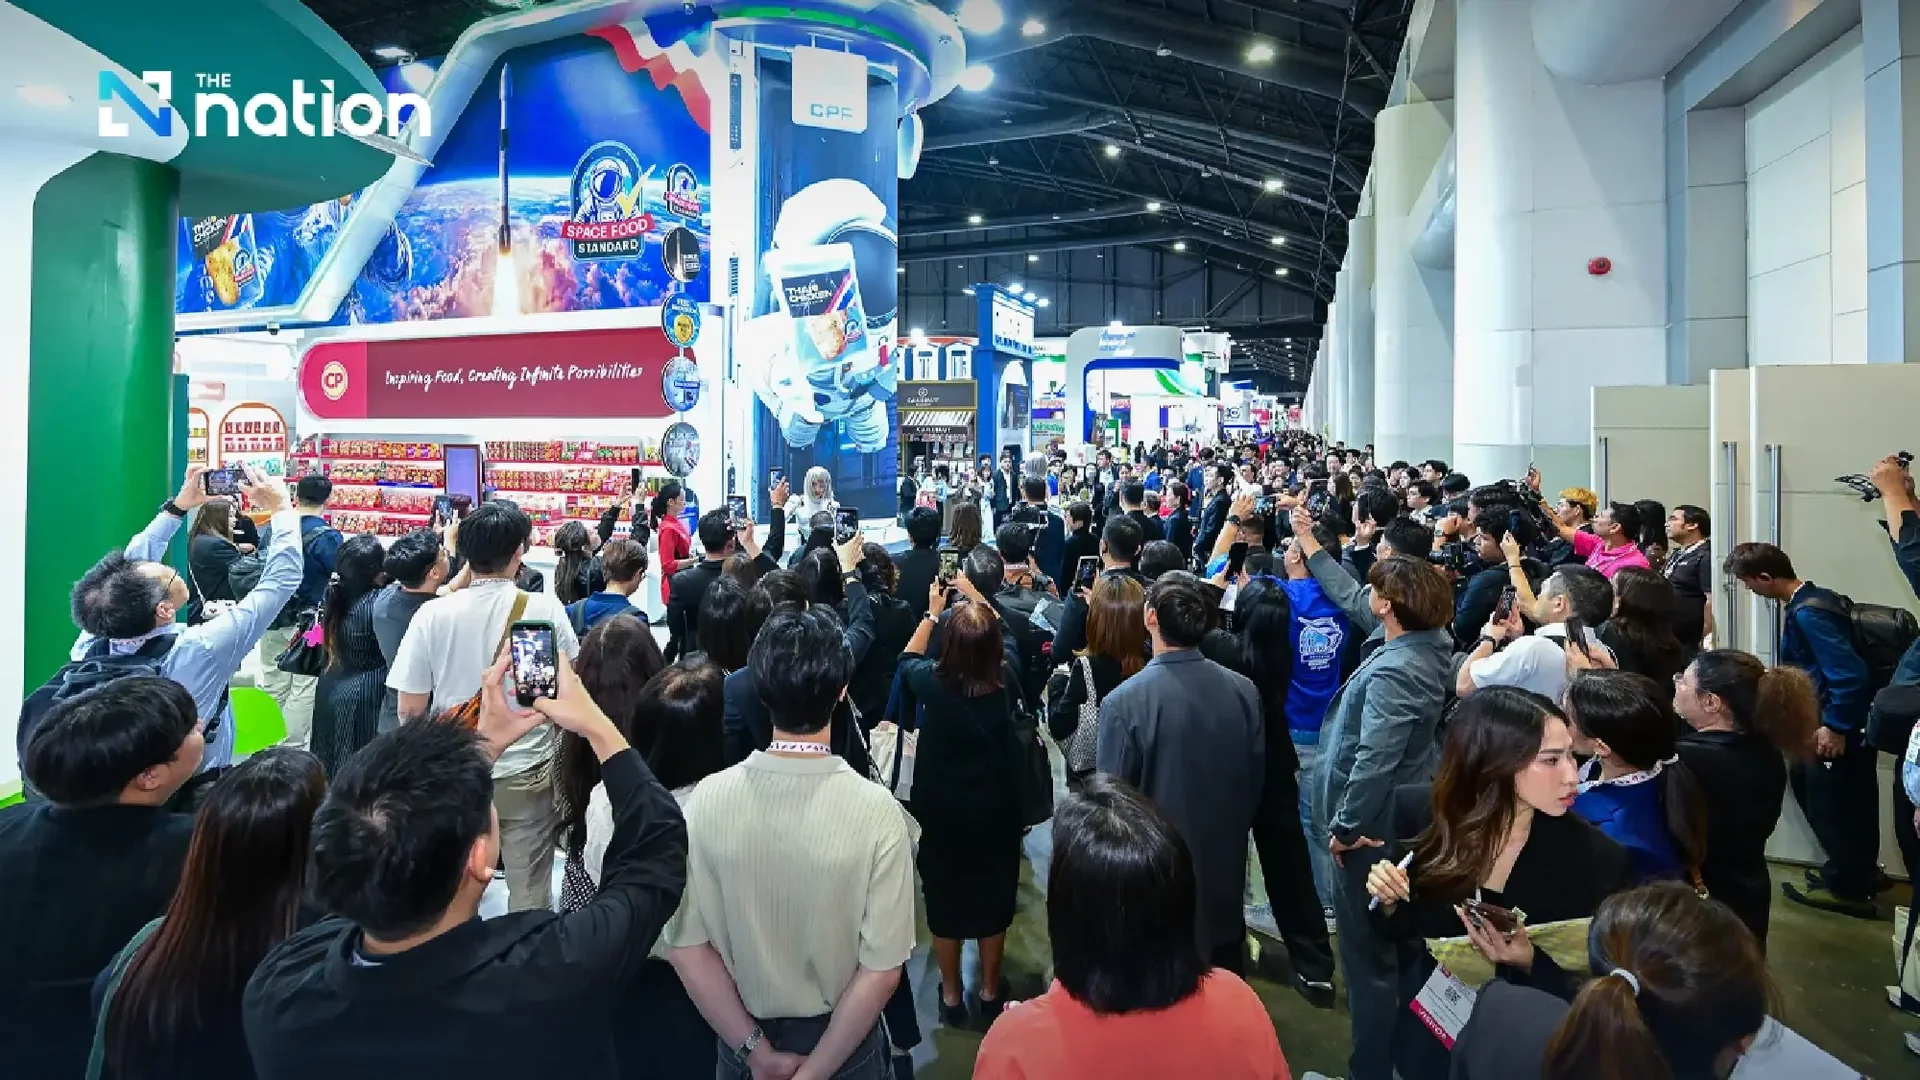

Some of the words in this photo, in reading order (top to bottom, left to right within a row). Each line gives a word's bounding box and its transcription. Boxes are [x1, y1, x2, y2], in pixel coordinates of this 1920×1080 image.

[810, 103, 854, 121] CPF
[566, 224, 608, 239] SPACE
[611, 218, 648, 236] FOOD
[578, 239, 639, 253] STANDARD
[325, 372, 344, 389] CP
[386, 370, 433, 392] Inspiring
[435, 368, 464, 384] Food,
[468, 366, 517, 390] Creating
[520, 364, 565, 386] Infinite
[568, 361, 643, 380] Possibilities
[1418, 1007, 1447, 1040] VISITOR
